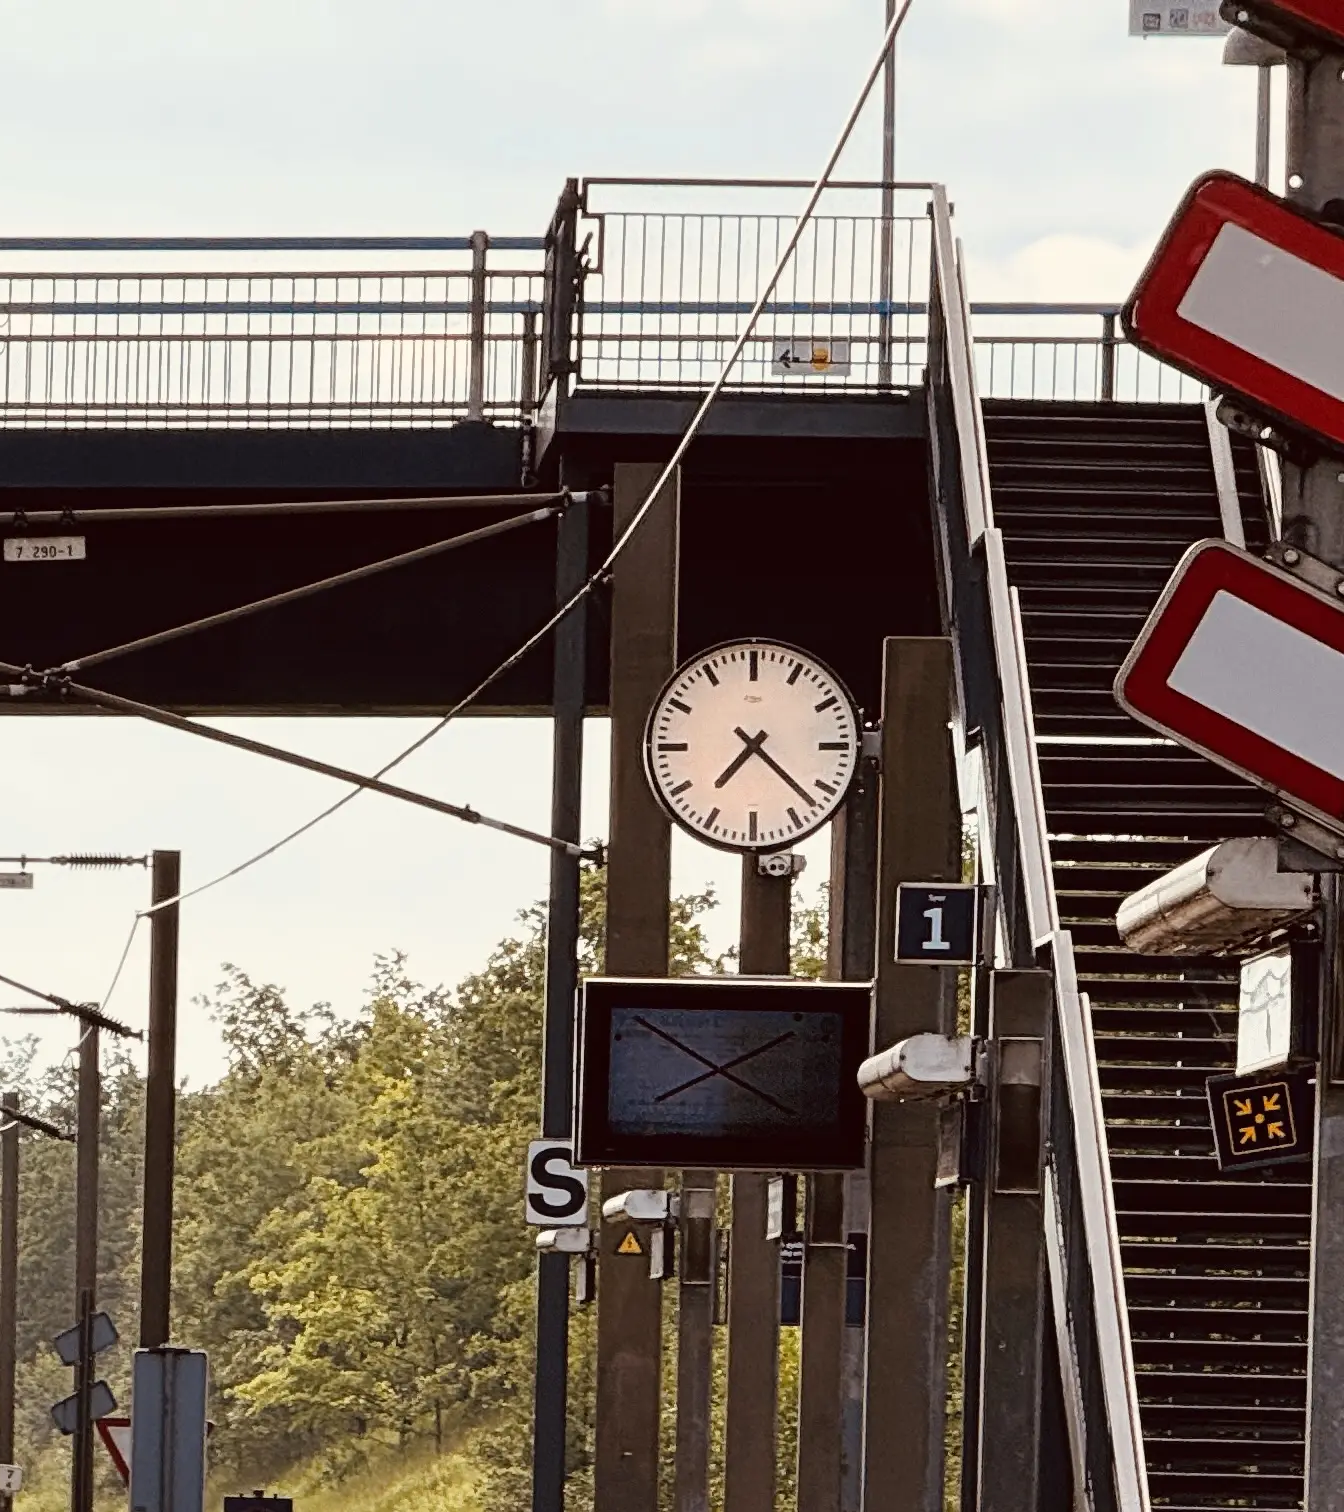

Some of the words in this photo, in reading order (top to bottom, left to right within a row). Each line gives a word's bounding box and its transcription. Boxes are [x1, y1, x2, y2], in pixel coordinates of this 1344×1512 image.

[15, 546, 23, 558] 7
[32, 545, 73, 558] 290-1
[921, 907, 951, 950] 1
[528, 1147, 586, 1218] S
[7, 1469, 15, 1479] 7
